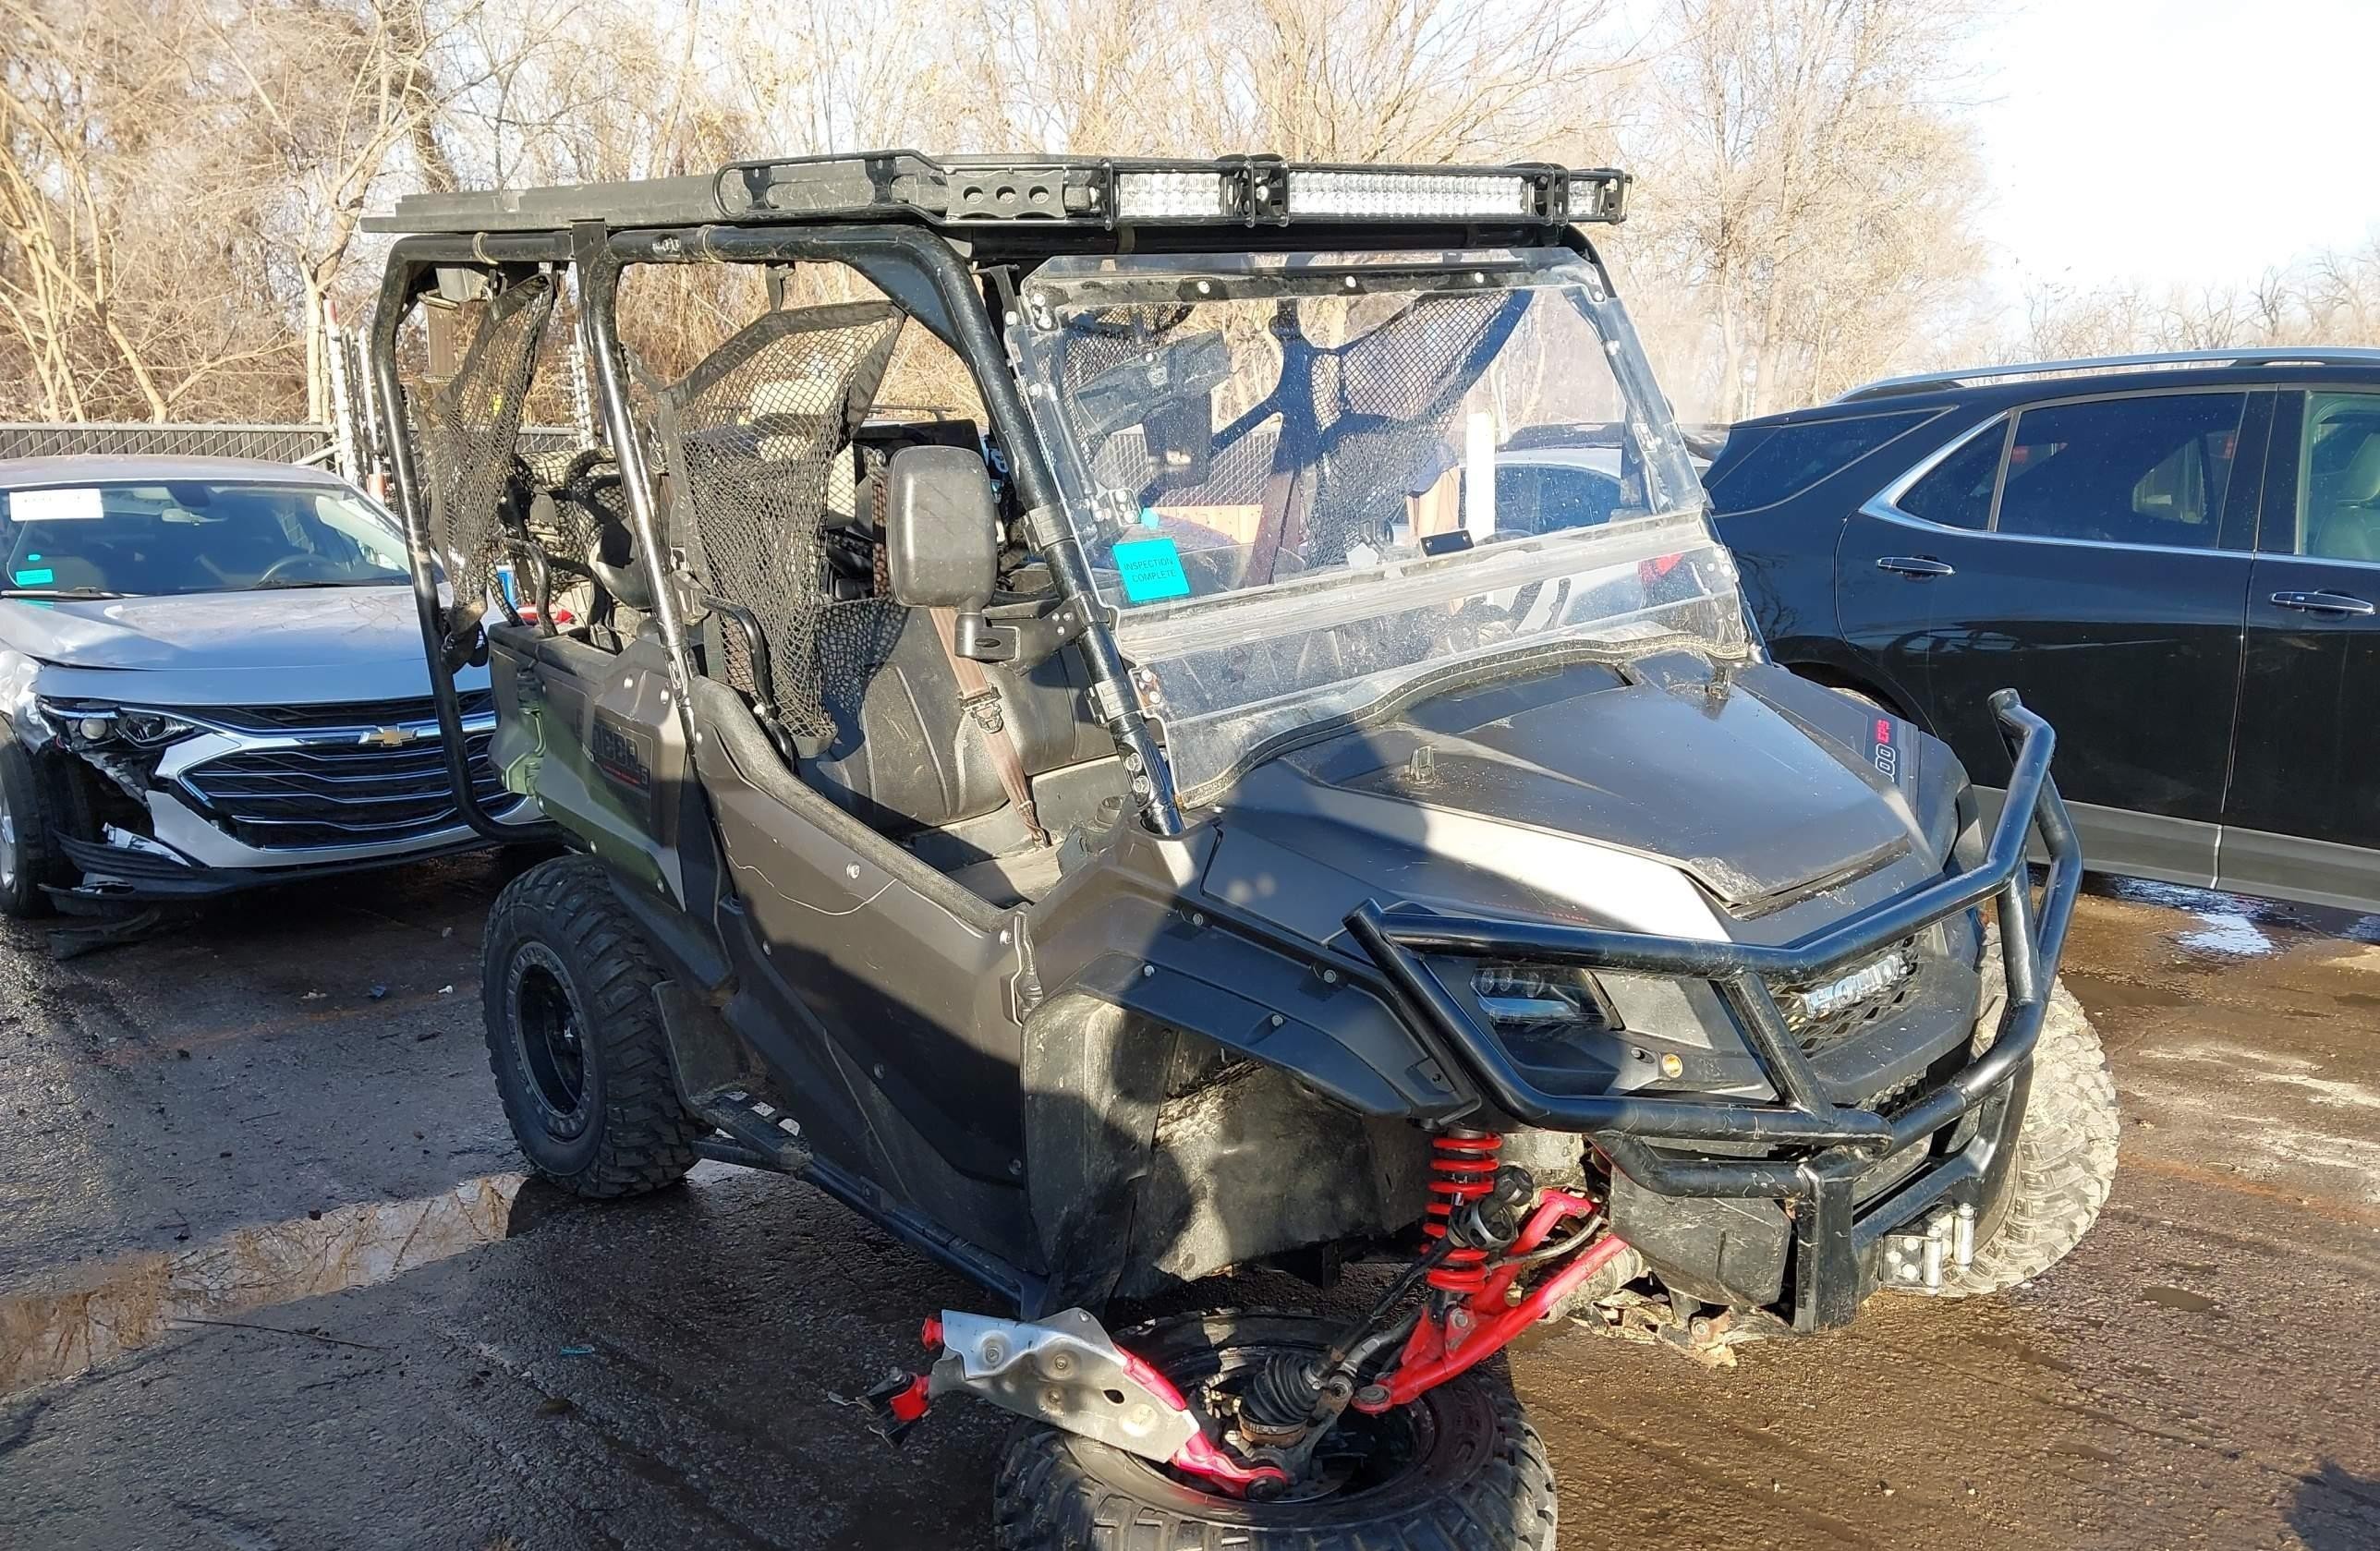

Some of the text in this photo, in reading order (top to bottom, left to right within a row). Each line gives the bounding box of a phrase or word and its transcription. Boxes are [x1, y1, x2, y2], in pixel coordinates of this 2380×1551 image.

[1123, 556, 1174, 571] INSPECTION
[1132, 569, 1177, 583] COMPLETE
[1876, 719, 1891, 744] EPS
